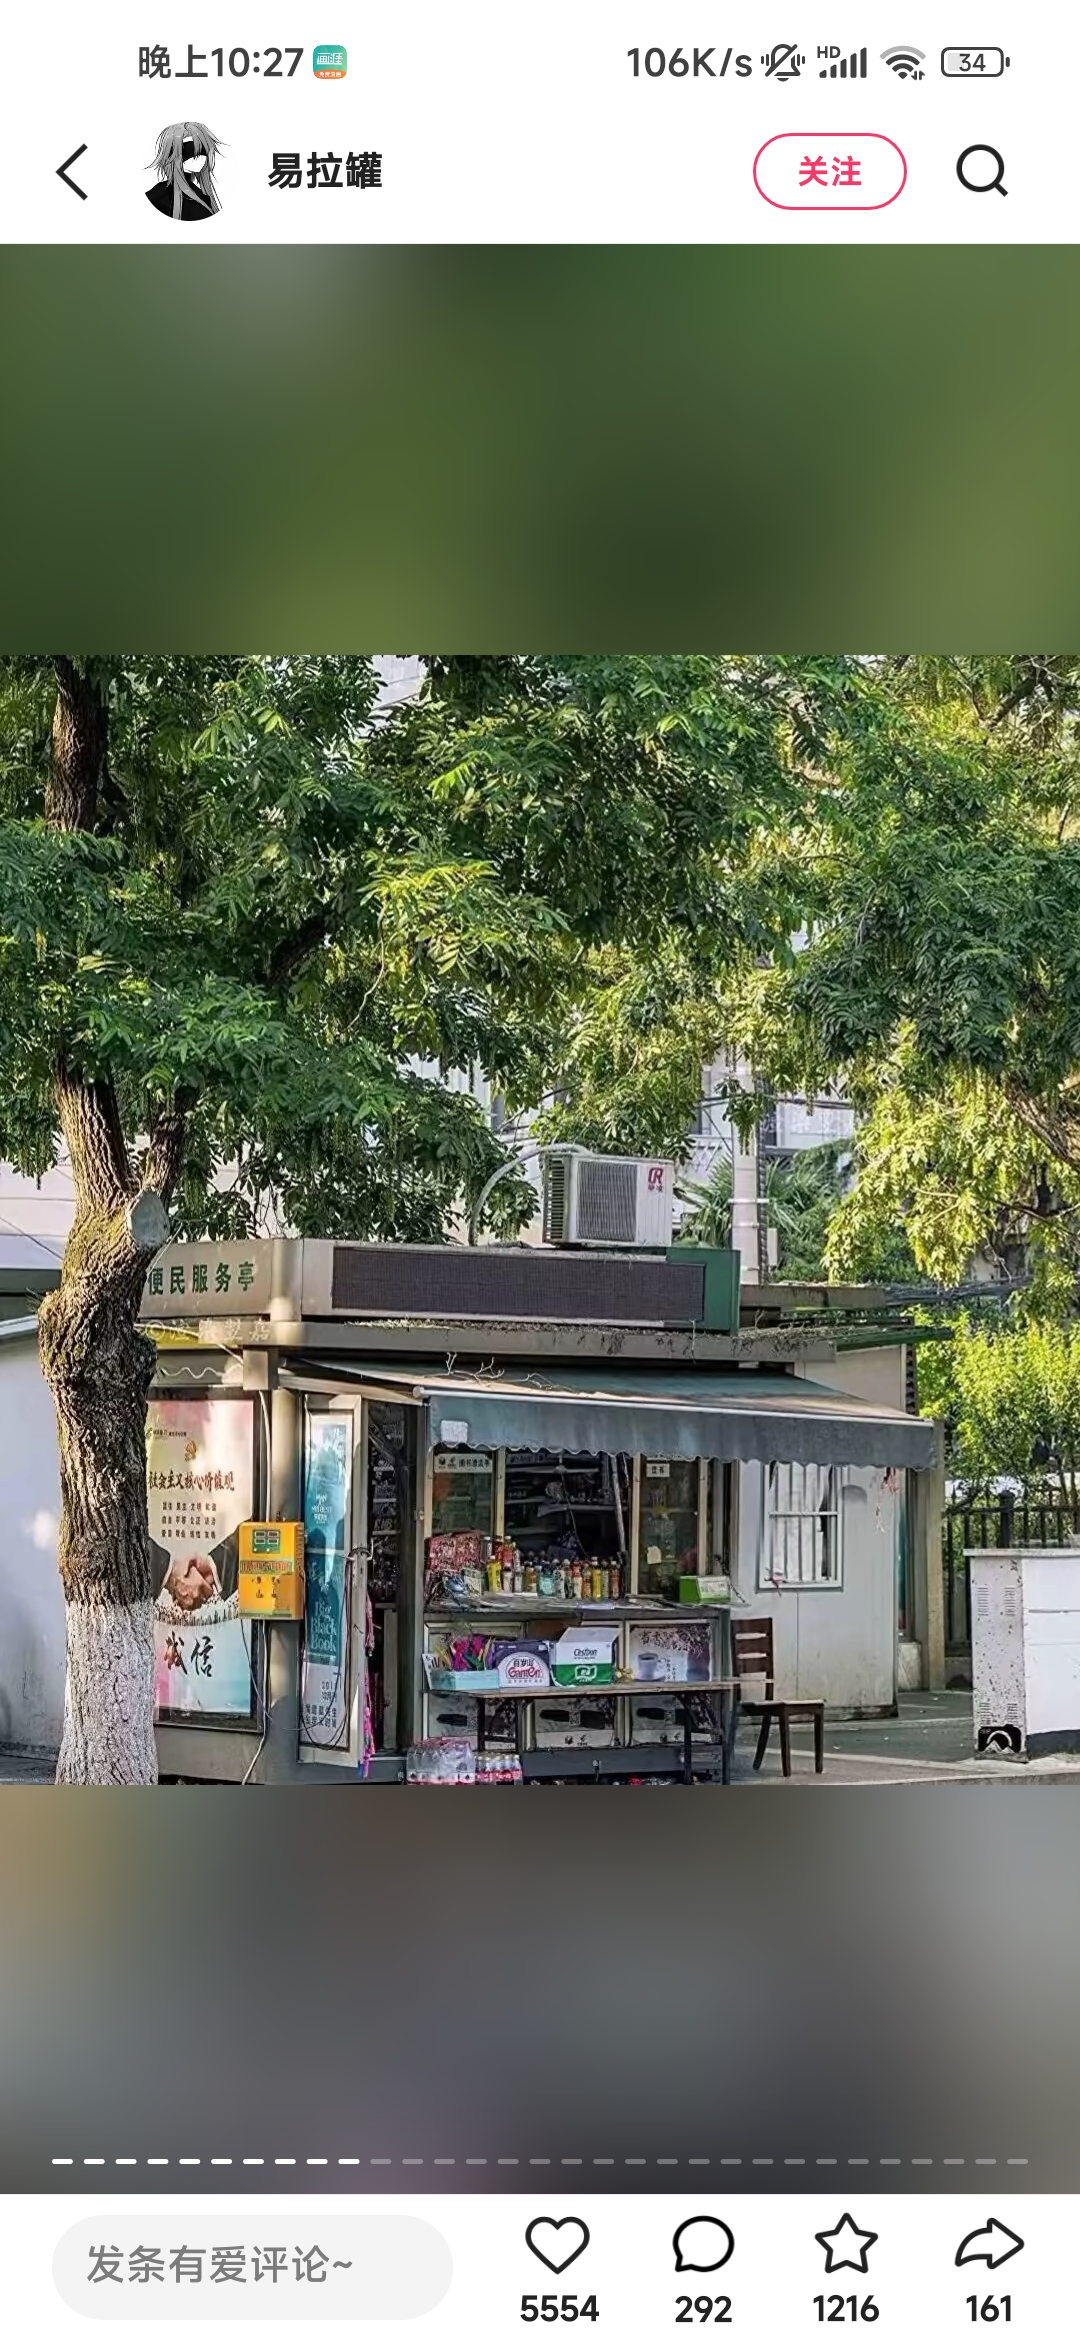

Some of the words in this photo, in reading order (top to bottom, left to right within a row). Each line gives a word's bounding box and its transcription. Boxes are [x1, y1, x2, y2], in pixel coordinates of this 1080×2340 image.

[148, 1261, 255, 1296] 便民服务亭
[148, 1469, 235, 1493] 社会主义核心价值观
